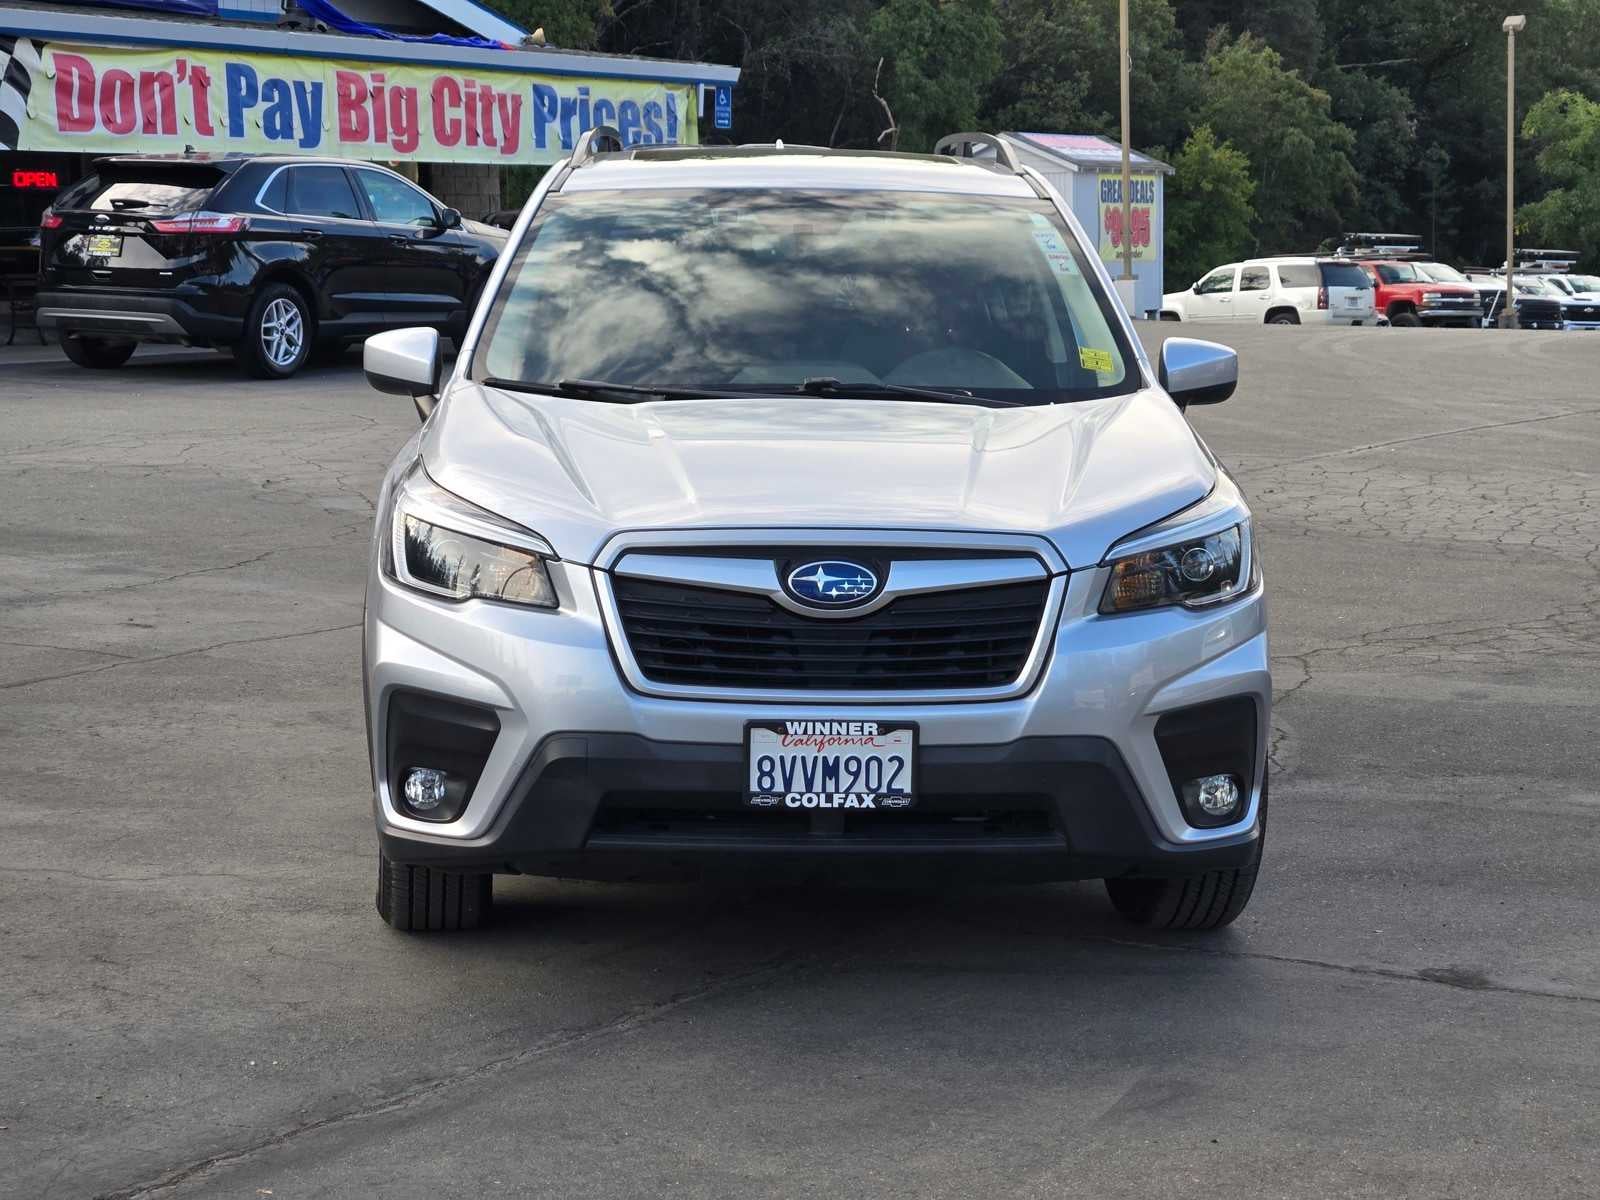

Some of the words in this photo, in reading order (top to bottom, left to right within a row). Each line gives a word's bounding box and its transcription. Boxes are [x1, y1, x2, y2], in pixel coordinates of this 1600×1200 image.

[52, 53, 214, 136] Don't
[226, 62, 323, 148] Pay
[336, 70, 419, 153] Big
[432, 75, 522, 154] City
[531, 83, 678, 150] Prices!
[13, 171, 57, 187] OPEN
[1101, 180, 1123, 203] GREA
[1129, 180, 1154, 203] DEALS
[1104, 206, 1151, 248] $995
[785, 721, 878, 735] WINNER
[781, 734, 885, 752] California
[757, 755, 905, 793] 8VVM902
[785, 793, 877, 808] COLFAX
